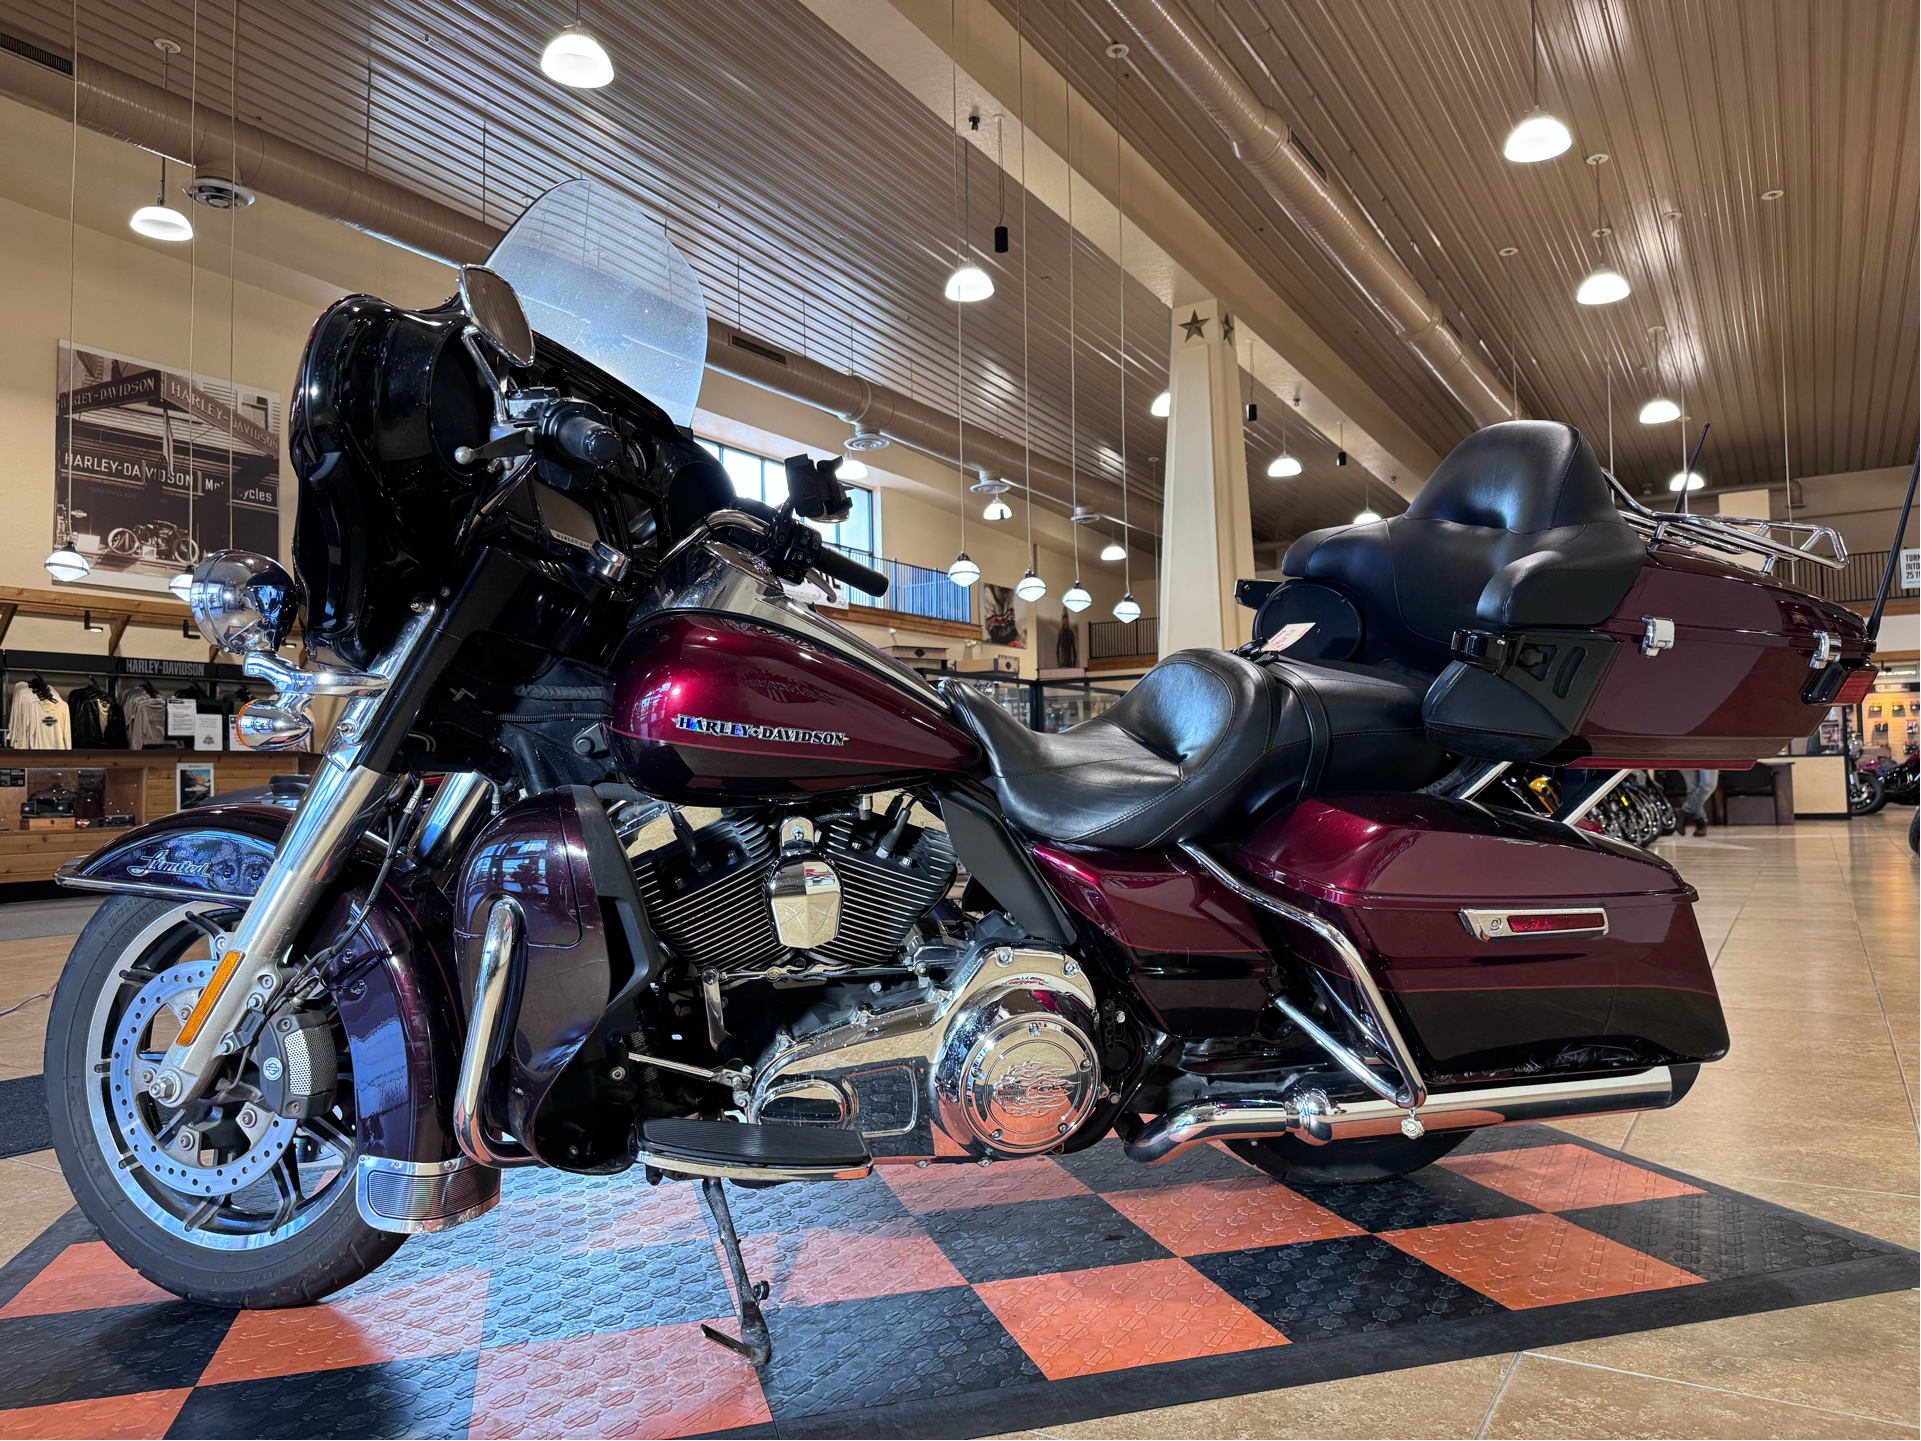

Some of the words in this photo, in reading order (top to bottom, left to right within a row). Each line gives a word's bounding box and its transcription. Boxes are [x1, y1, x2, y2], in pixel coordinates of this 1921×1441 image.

[1906, 571, 1914, 579] 25
[126, 658, 205, 676] HARLEY-DAVIDSON
[126, 848, 214, 878] Limited
